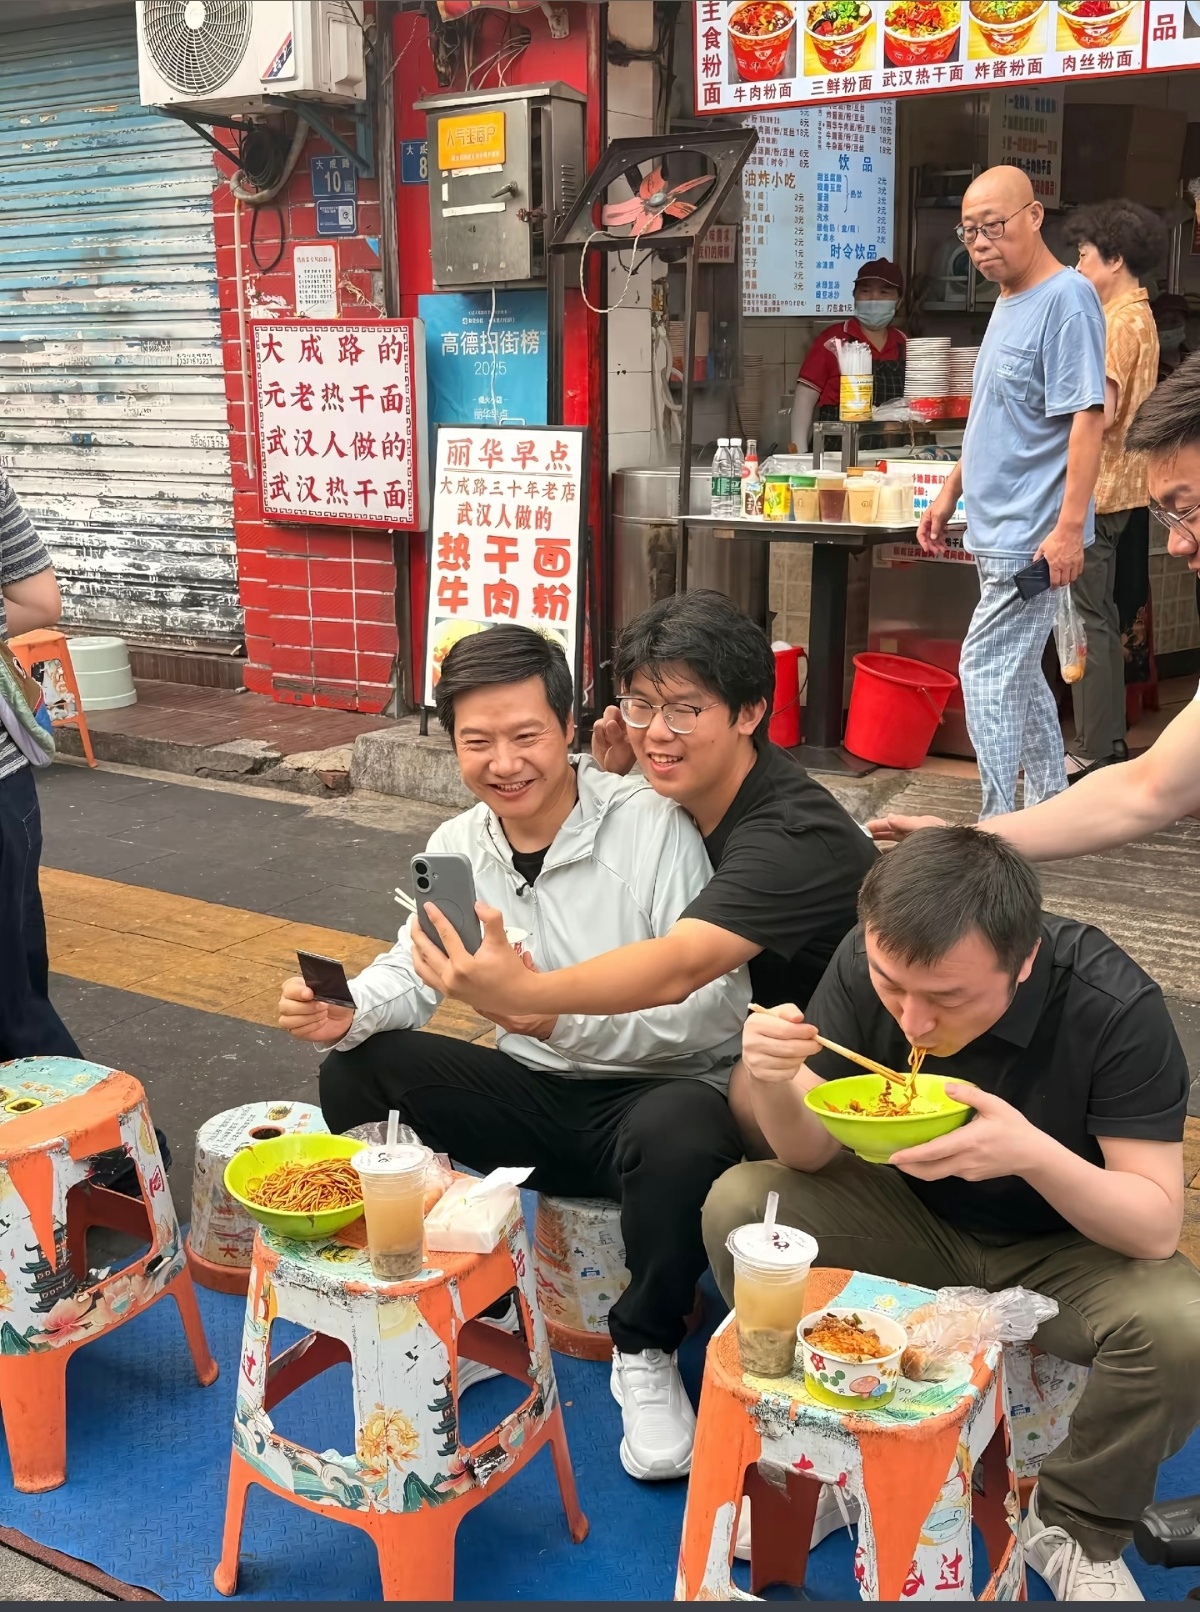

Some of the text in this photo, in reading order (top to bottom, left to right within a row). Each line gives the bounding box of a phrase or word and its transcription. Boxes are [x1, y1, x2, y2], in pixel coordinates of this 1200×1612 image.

[1152, 14, 1177, 41] 品
[701, 1, 722, 106] 主食粉面
[733, 50, 1133, 103] 牛肉粉面 三鲜粉面 武汉热干面 炸酱粉面 肉丝粉面
[316, 159, 350, 170] 大成路
[838, 154, 873, 173] 饮品
[325, 171, 341, 193] 10
[745, 170, 796, 189] 油炸小吃
[830, 243, 878, 260] 时令饮品
[261, 333, 403, 366] 大成路的
[441, 329, 540, 356] 高德扫街榜
[474, 361, 507, 376] 2025
[263, 381, 404, 414] 元老热干面
[266, 425, 406, 462] 武汉人做的
[447, 437, 572, 472] 丽华早点
[268, 471, 406, 510] 武汉热干面
[440, 476, 577, 503] 大成路三十年老店
[457, 501, 553, 532] 武汉人做的
[437, 532, 572, 578] 热干面
[437, 575, 572, 622] 牛肉粉
